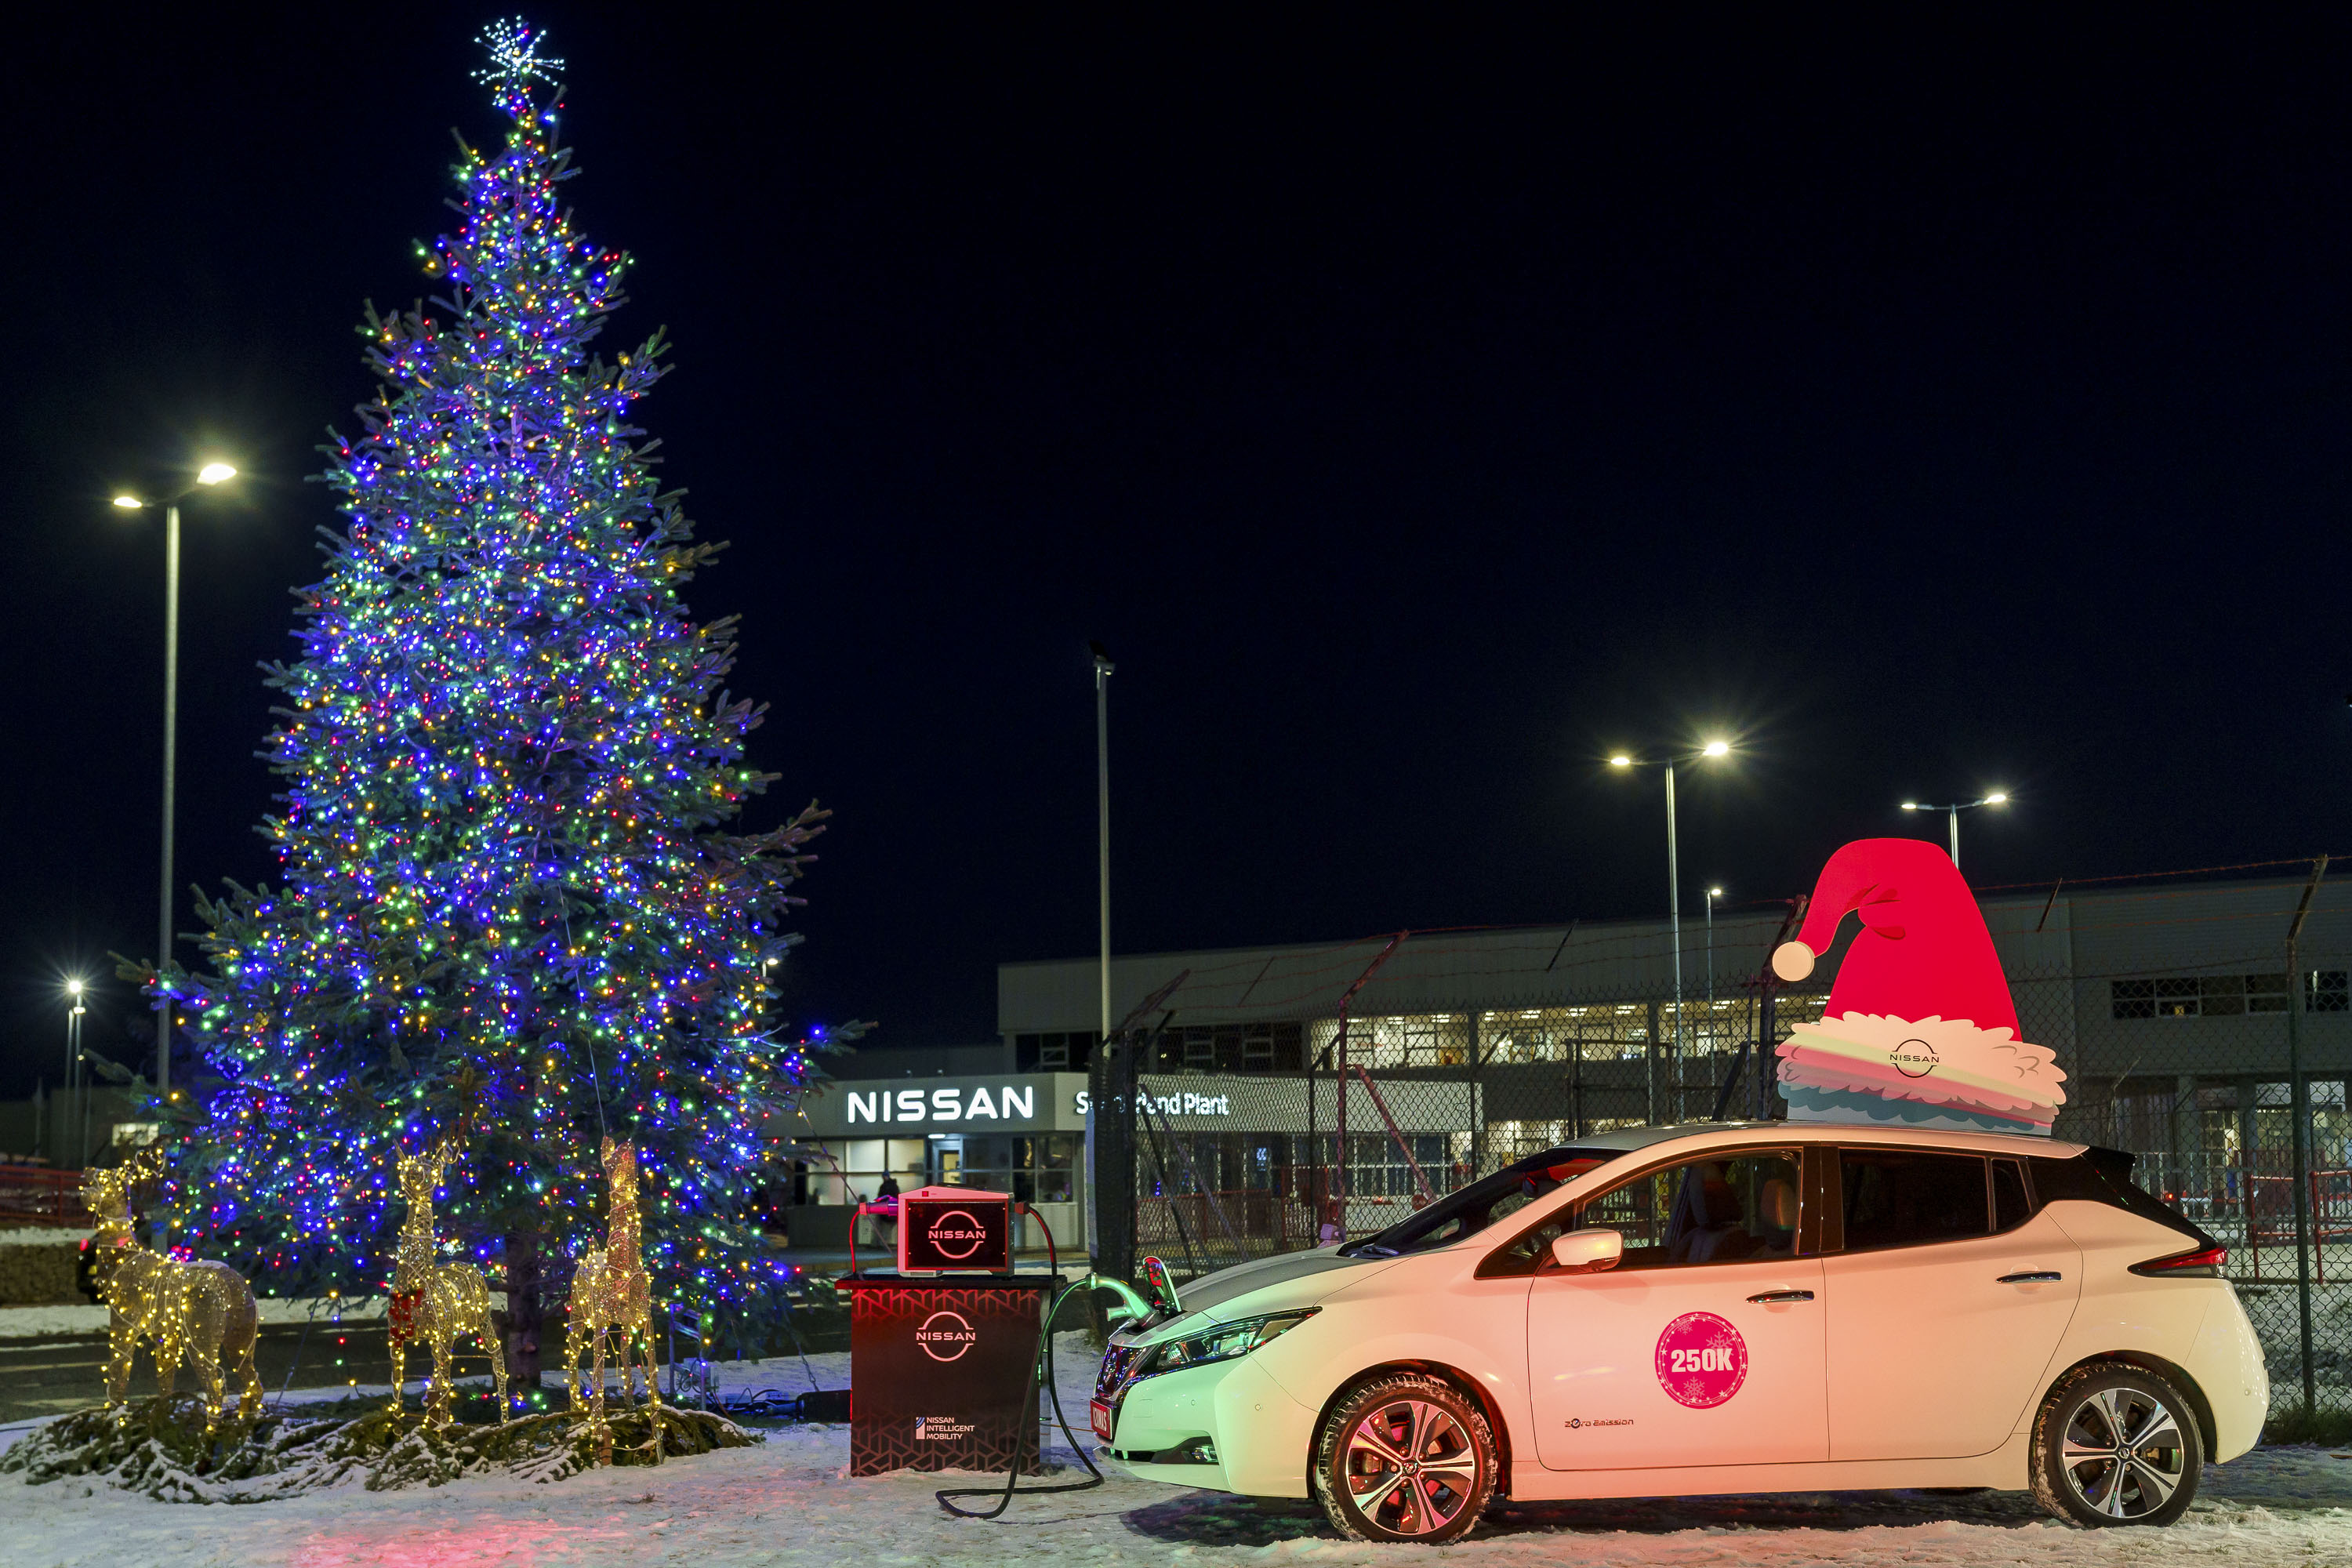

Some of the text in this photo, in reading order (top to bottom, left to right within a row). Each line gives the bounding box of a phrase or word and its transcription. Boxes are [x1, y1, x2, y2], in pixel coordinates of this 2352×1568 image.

[1889, 1054, 1940, 1063] NISSAN
[848, 1086, 1033, 1123] NISSAN
[1184, 1092, 1230, 1116] Plant
[927, 1230, 986, 1240] NISSAN
[916, 1332, 976, 1341] NISSAN
[1671, 1348, 1734, 1373] 250K
